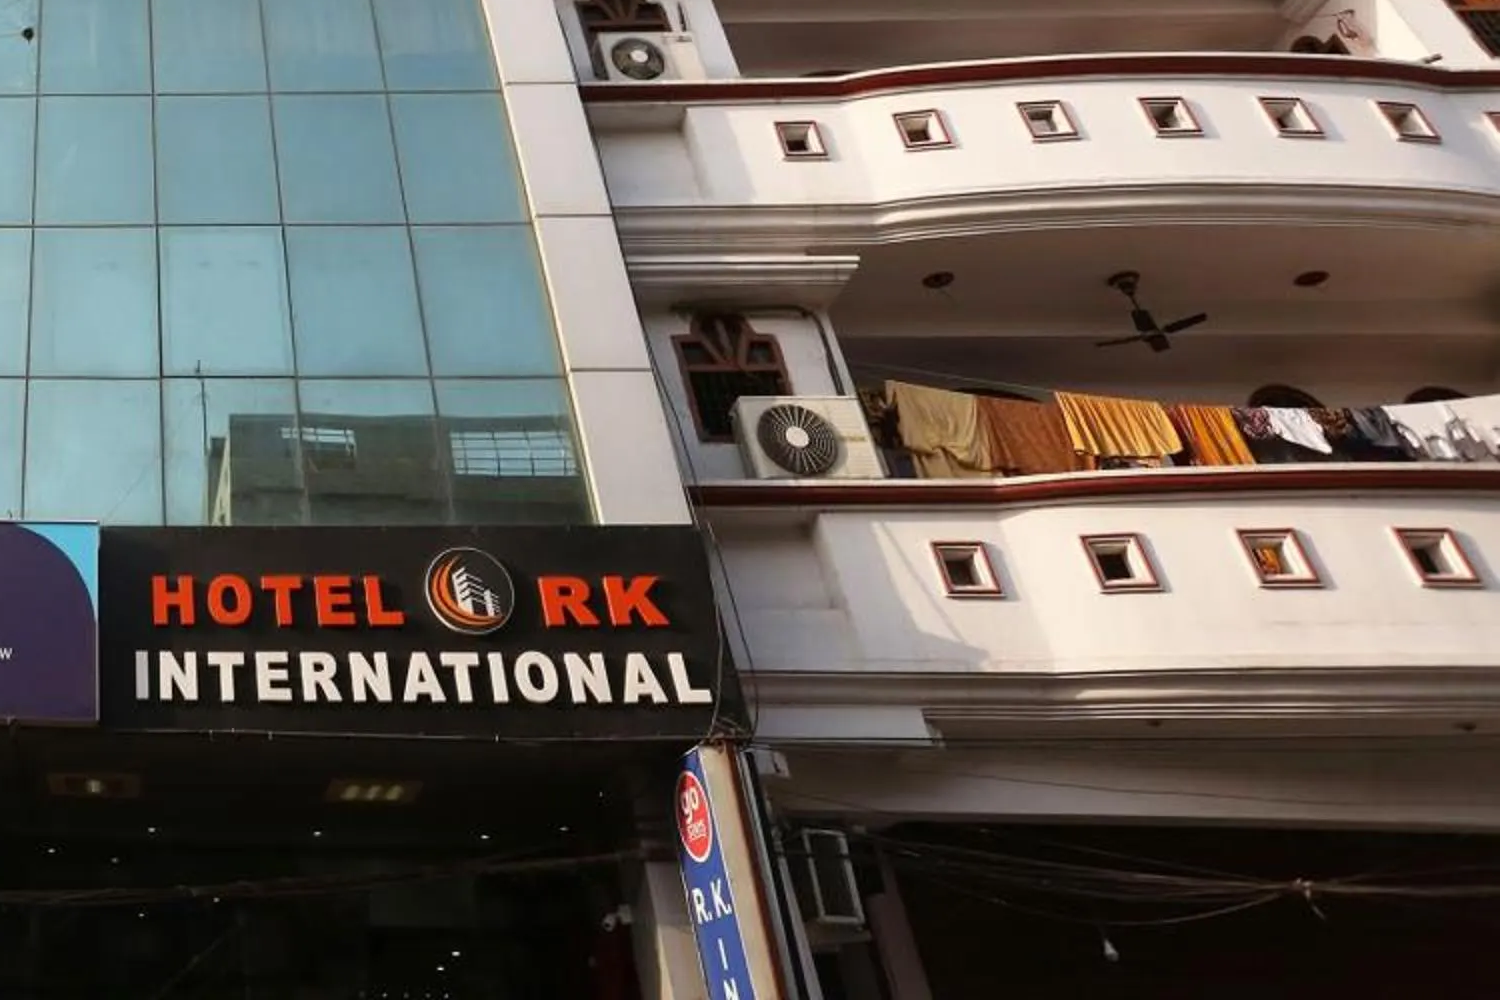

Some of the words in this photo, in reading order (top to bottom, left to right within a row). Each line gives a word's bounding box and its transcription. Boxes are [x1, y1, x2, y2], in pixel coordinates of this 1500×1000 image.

[151, 574, 406, 628] HOTEL
[536, 574, 671, 628] RK
[134, 649, 714, 704] INTERNATIONAL
